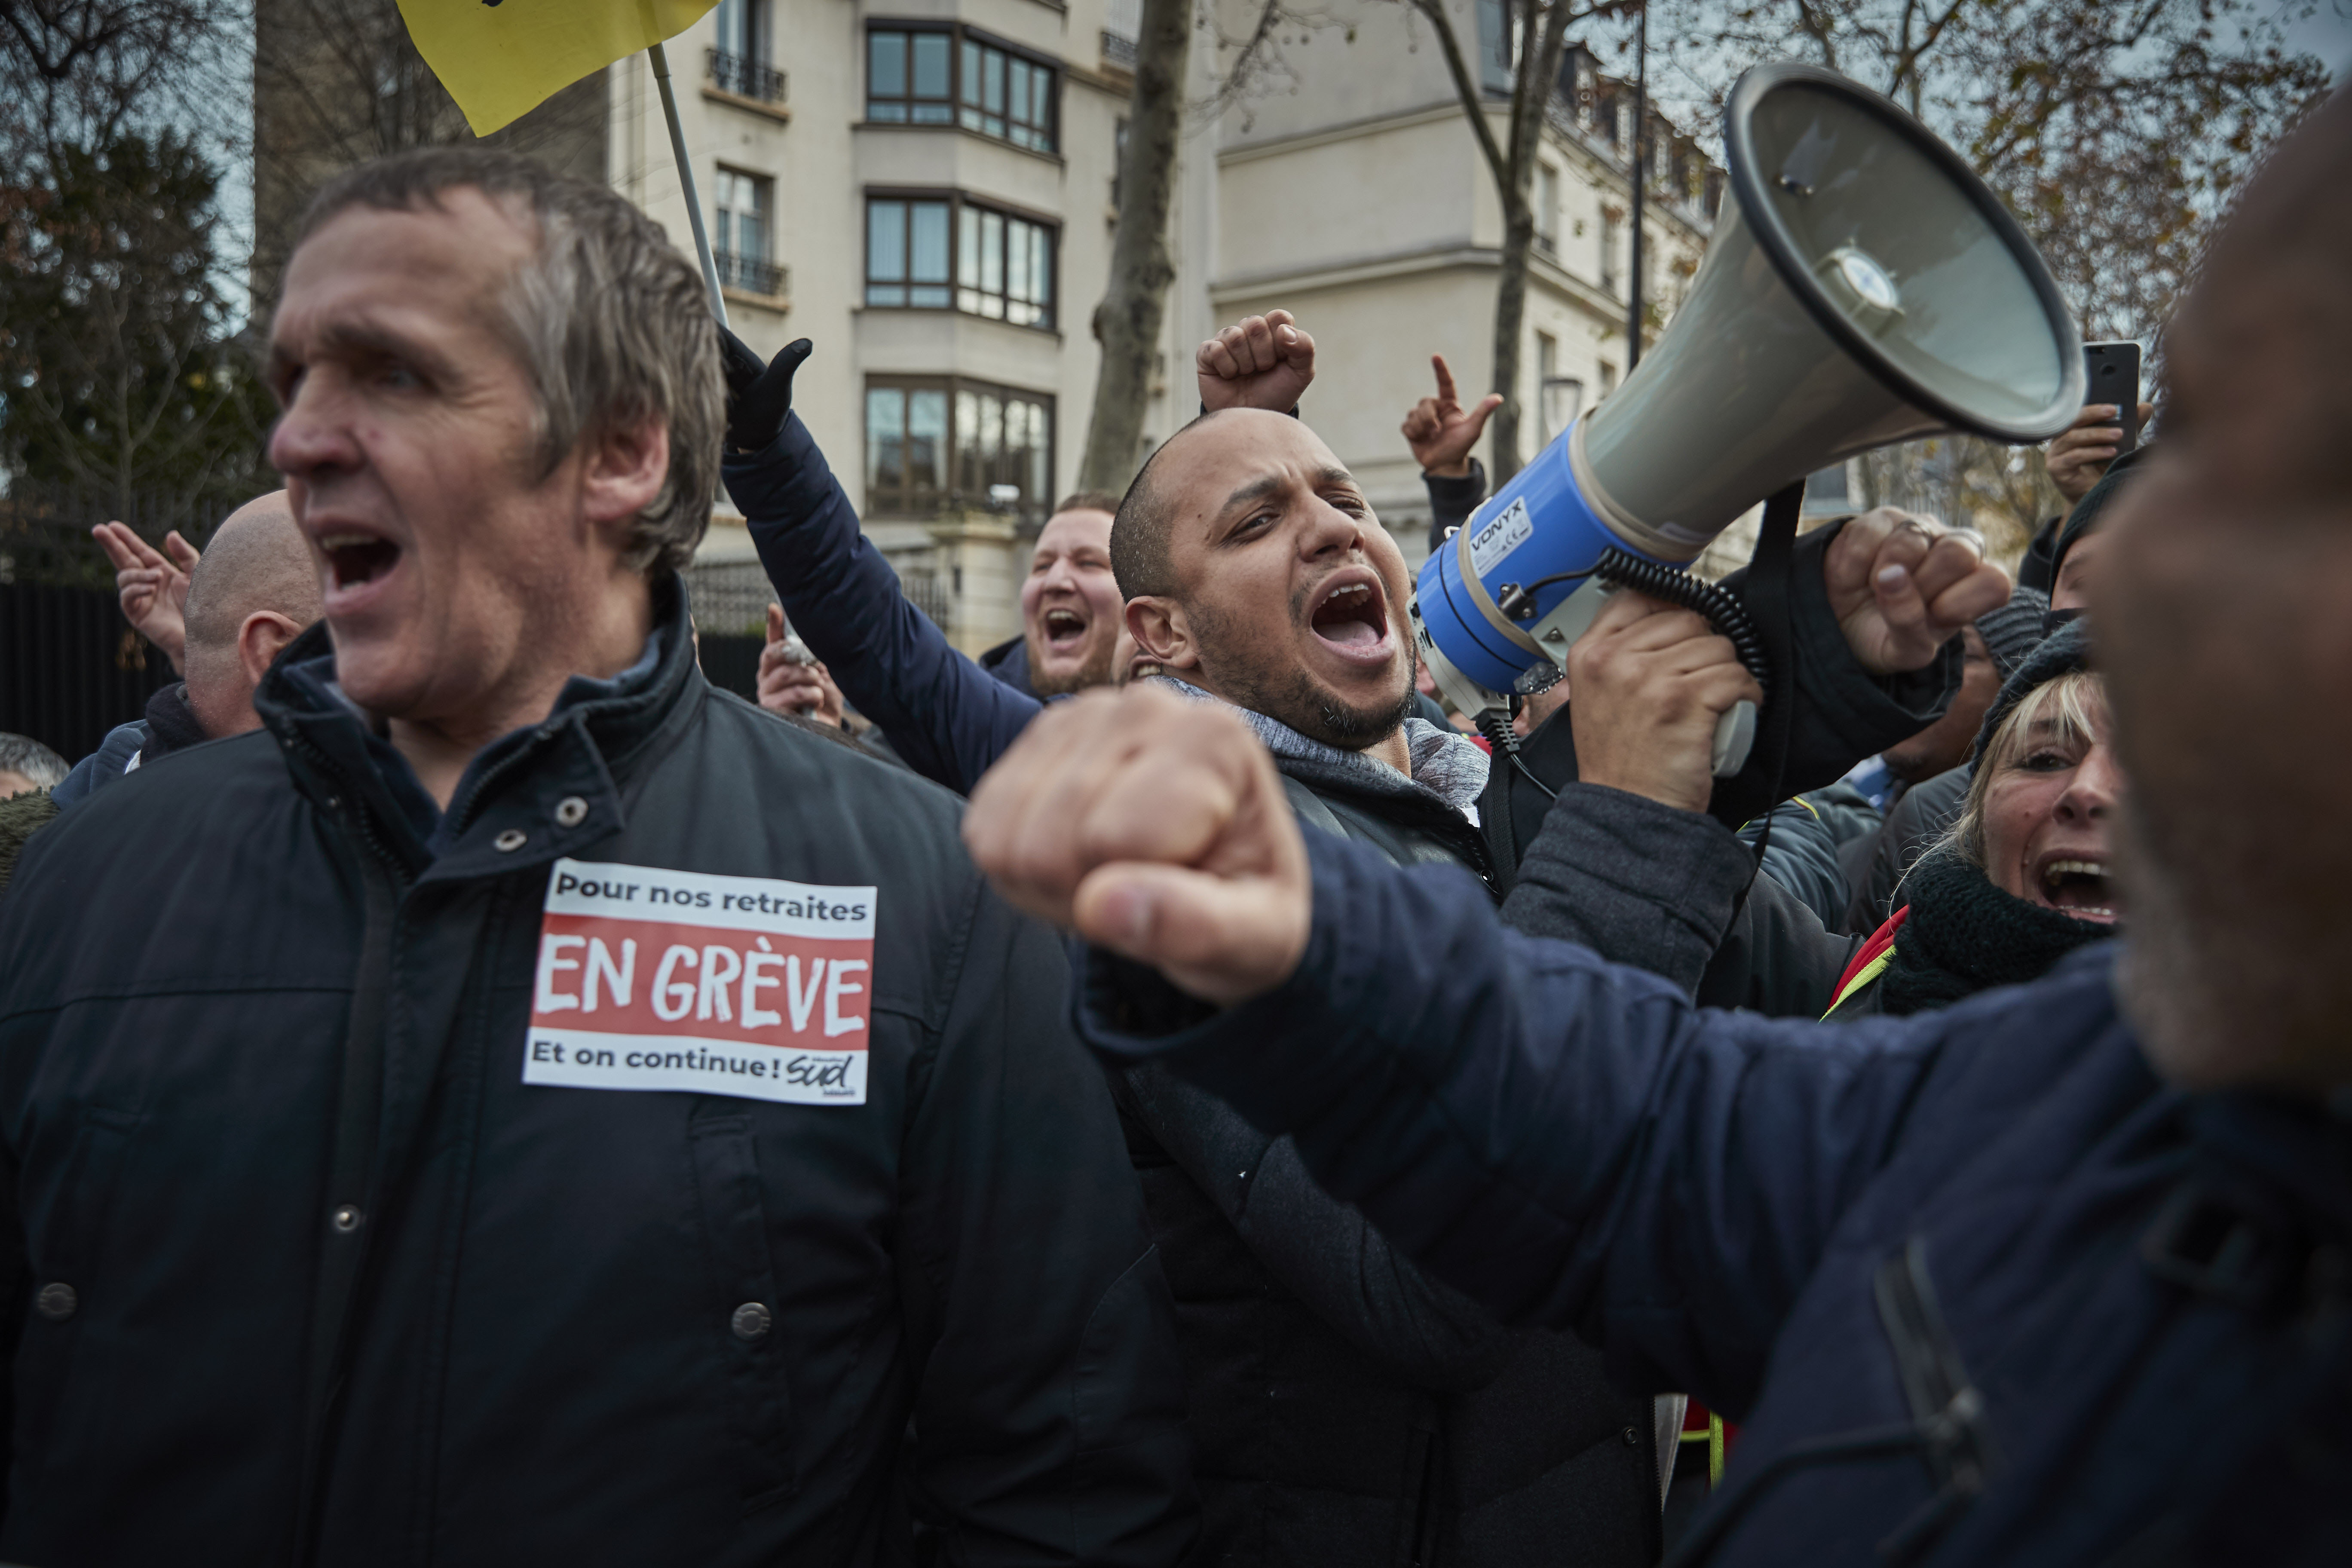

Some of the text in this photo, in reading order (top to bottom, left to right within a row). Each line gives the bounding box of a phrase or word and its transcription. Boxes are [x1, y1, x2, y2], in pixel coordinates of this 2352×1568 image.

[1471, 501, 1522, 551] VONYX
[556, 872, 866, 921] Pour nos retraites
[535, 934, 869, 1037] EN GRÈVE
[532, 1041, 564, 1063] Et
[575, 1049, 615, 1067] on
